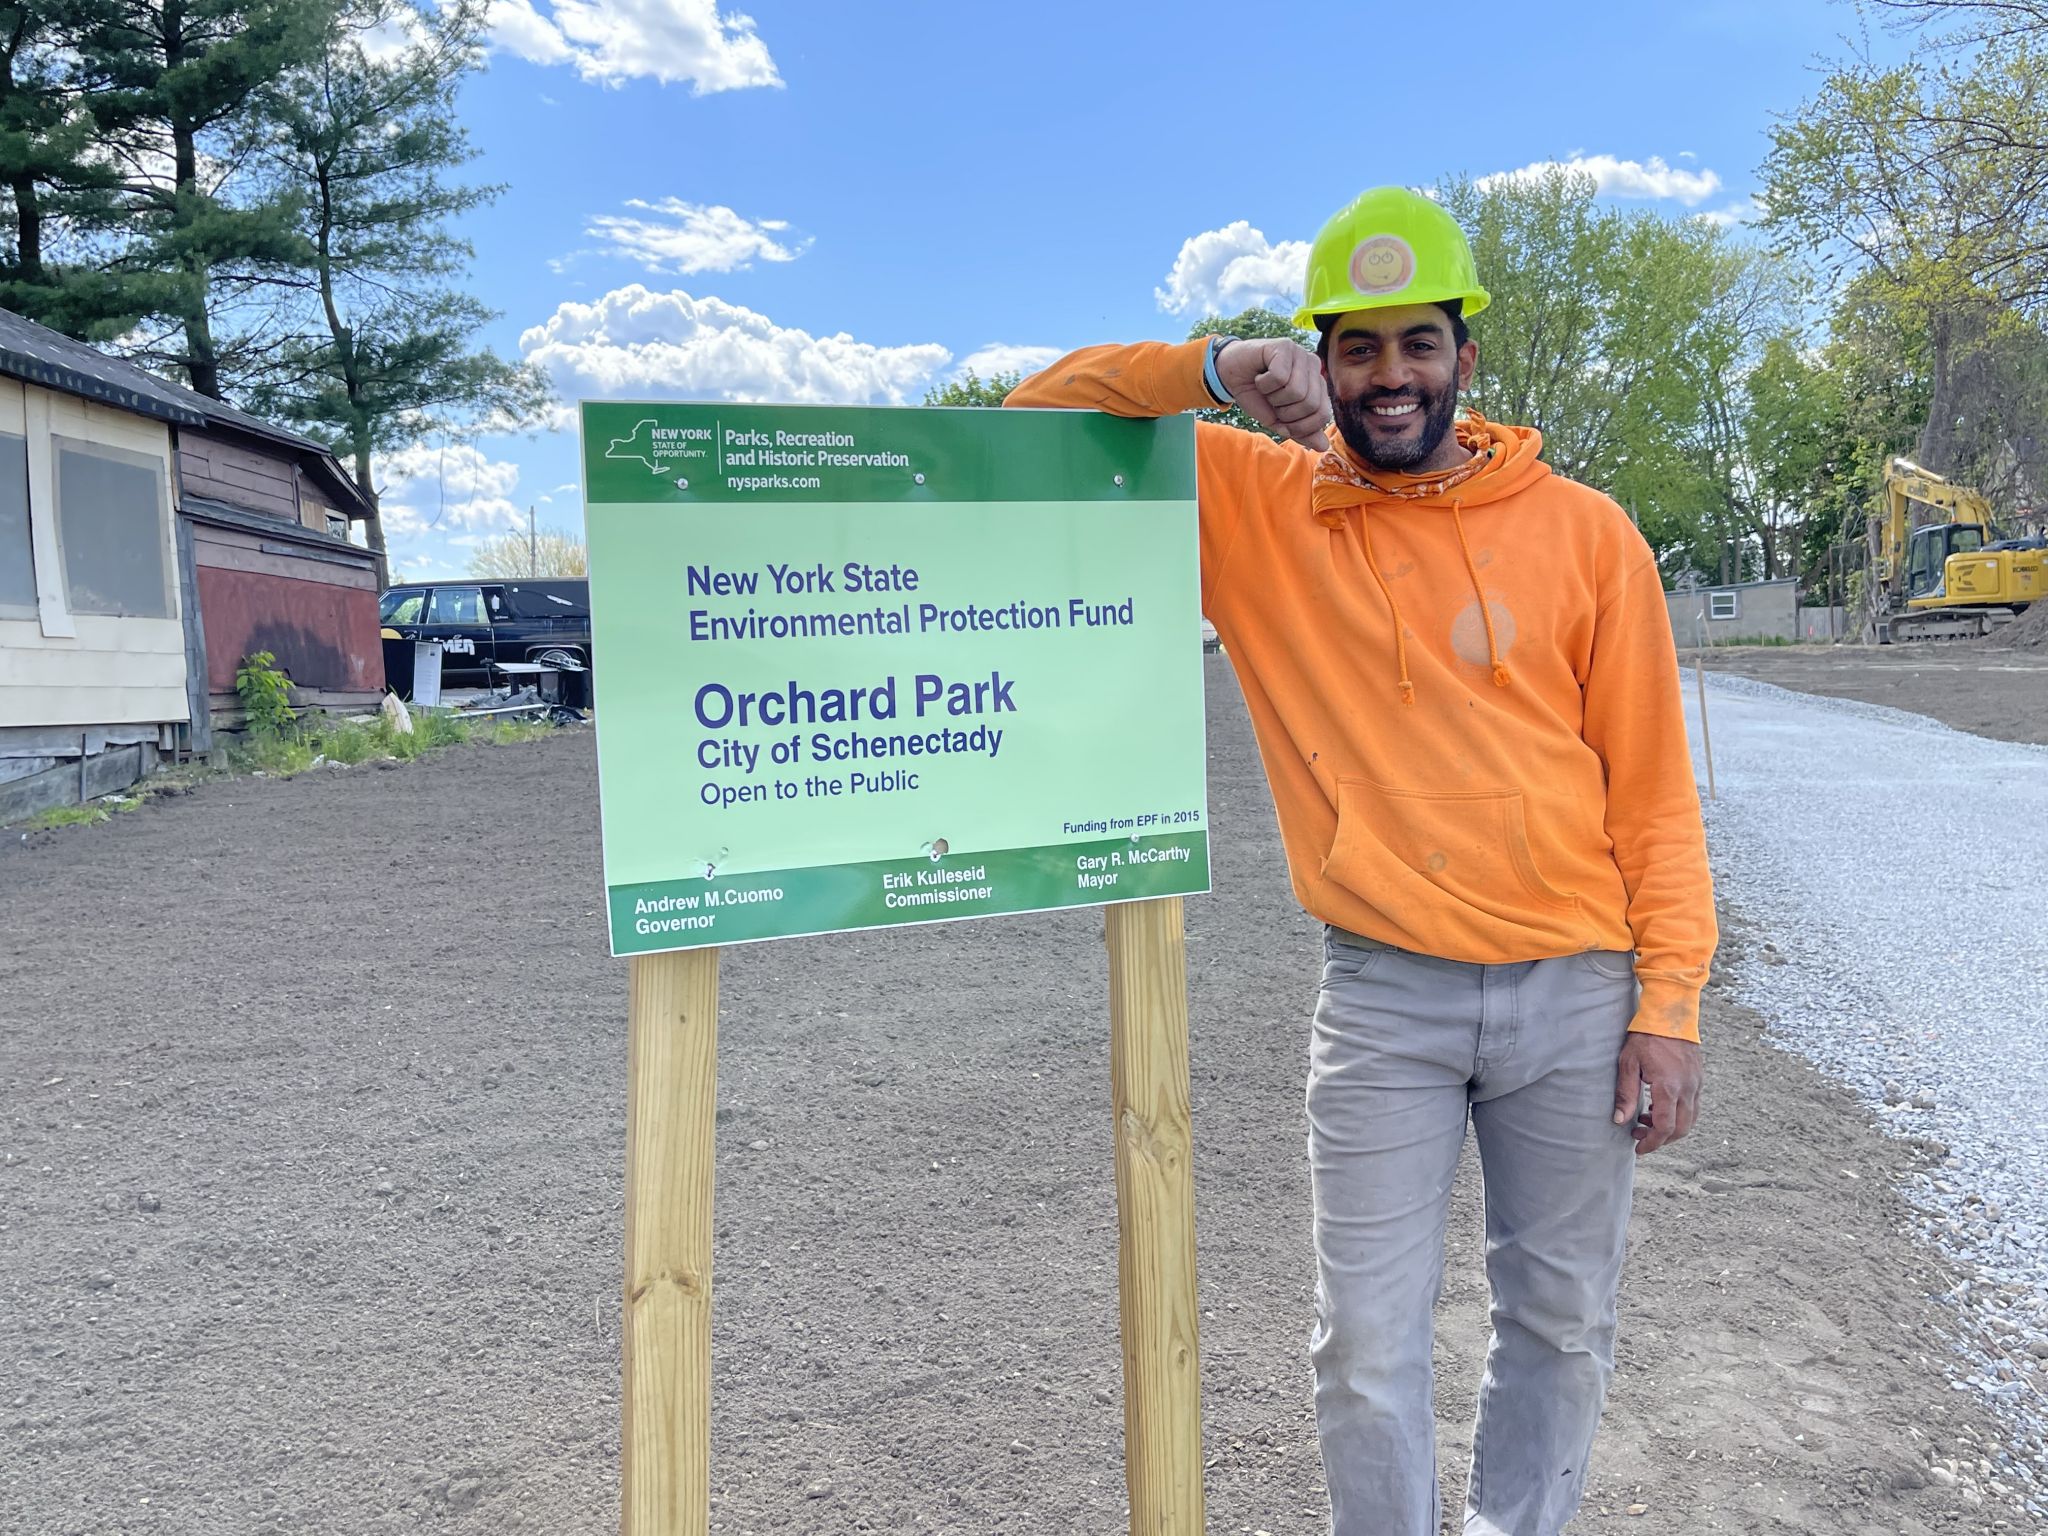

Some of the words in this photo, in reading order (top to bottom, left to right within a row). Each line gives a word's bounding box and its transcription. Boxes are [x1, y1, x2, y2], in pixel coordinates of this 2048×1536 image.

[652, 429, 678, 440] NEW
[680, 429, 712, 440] YORK
[652, 441, 675, 449] STATE
[725, 430, 773, 448] Parks,
[776, 431, 854, 447] Recreation
[726, 449, 755, 466] and
[759, 450, 815, 466] Historic
[818, 451, 909, 467] Preservation
[727, 475, 820, 491] nysparks.com
[687, 566, 758, 596] New
[767, 564, 835, 594] York
[843, 563, 919, 592] State
[689, 605, 909, 641] Environmental
[919, 601, 1060, 632] Protection
[1069, 597, 1134, 627] Fund
[694, 676, 897, 728] Orchard
[915, 671, 1017, 717] Park
[698, 739, 759, 773] City
[771, 735, 801, 765] of
[811, 725, 1003, 761] Schenectady
[700, 782, 767, 809] Open
[774, 780, 798, 799] to
[805, 776, 842, 797] the
[850, 770, 919, 794] Public
[1063, 820, 1107, 834] Funding
[1110, 817, 1134, 829] from
[1137, 814, 1159, 827] EPF
[1161, 813, 1171, 824] in
[1174, 810, 1200, 823] 2015
[1077, 855, 1107, 871] Gary
[1111, 852, 1125, 867] R.
[1129, 846, 1191, 864] McCarthy
[883, 872, 913, 889] Erik
[917, 865, 986, 886] Kulleseid
[1077, 873, 1118, 889] Mayor
[634, 896, 700, 915] Andrew
[885, 886, 993, 908] Commissioner
[635, 914, 716, 935] Governor
